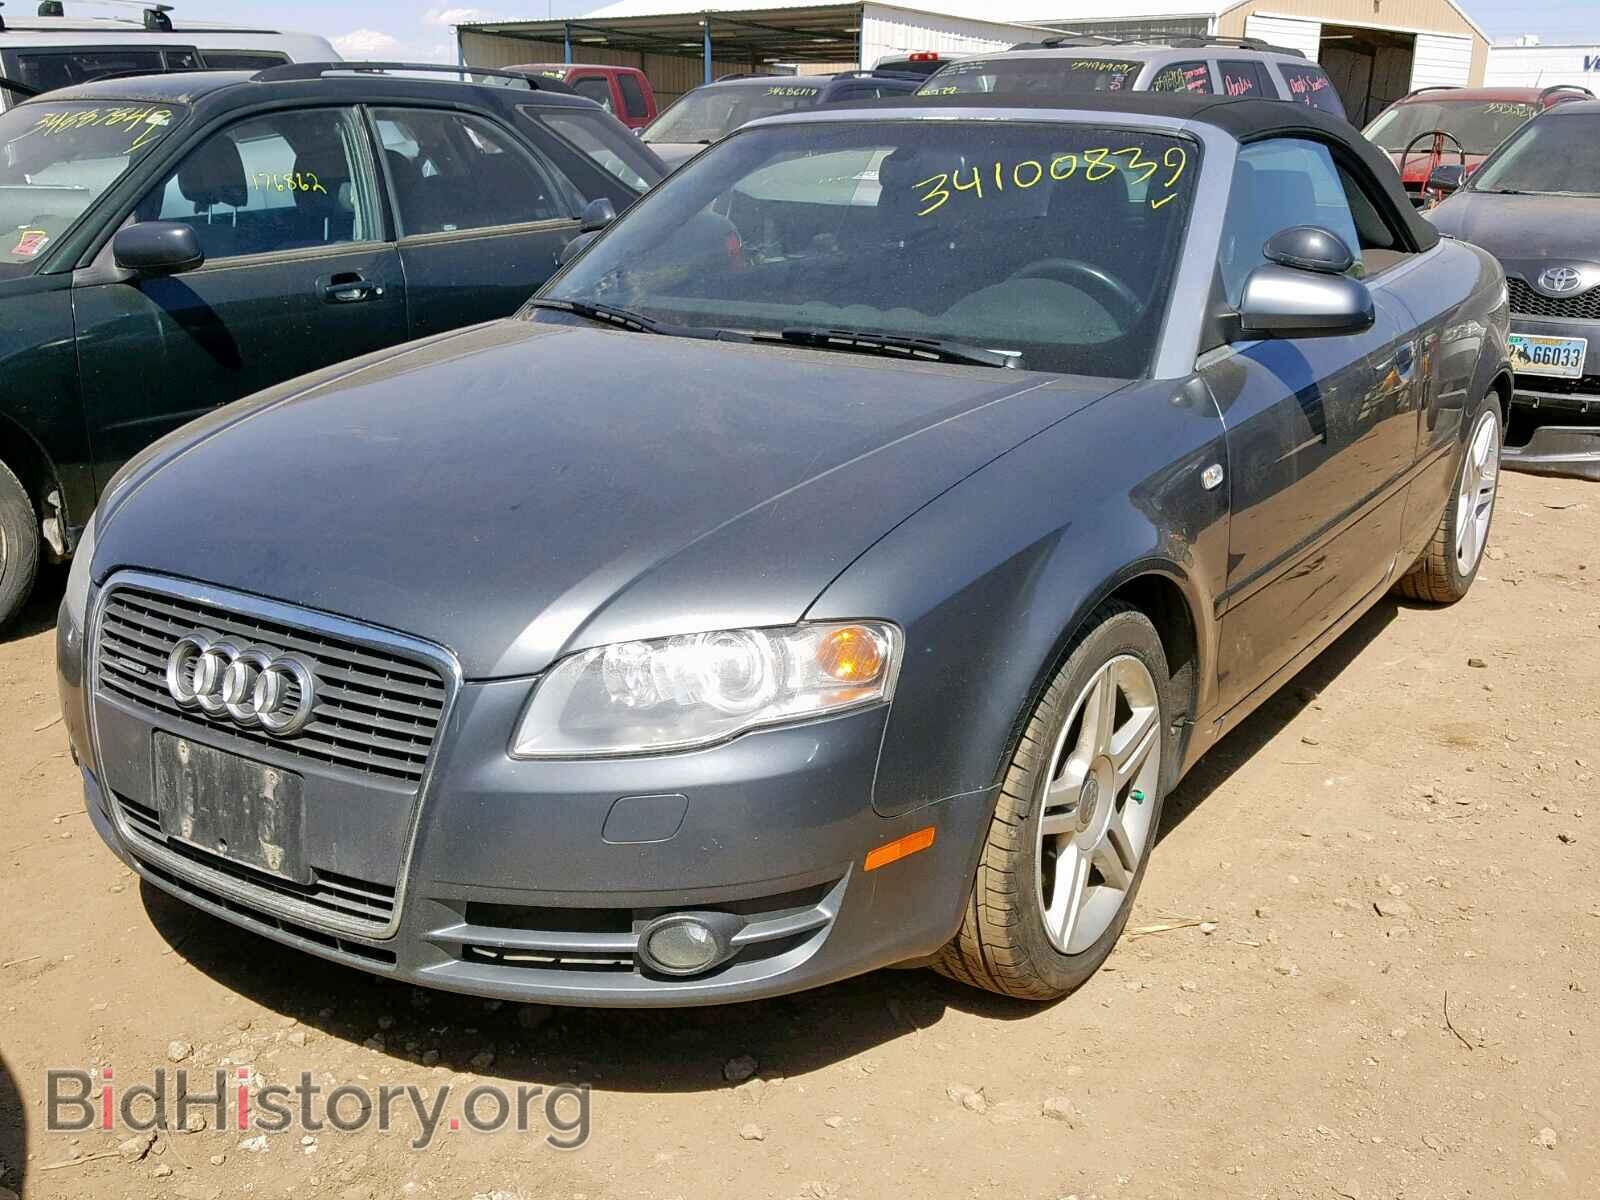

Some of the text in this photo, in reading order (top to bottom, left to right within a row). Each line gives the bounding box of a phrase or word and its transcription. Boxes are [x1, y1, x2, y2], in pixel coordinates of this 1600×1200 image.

[252, 172, 327, 195] 176862
[911, 148, 1187, 216] 34100839
[1533, 346, 1581, 367] 66033
